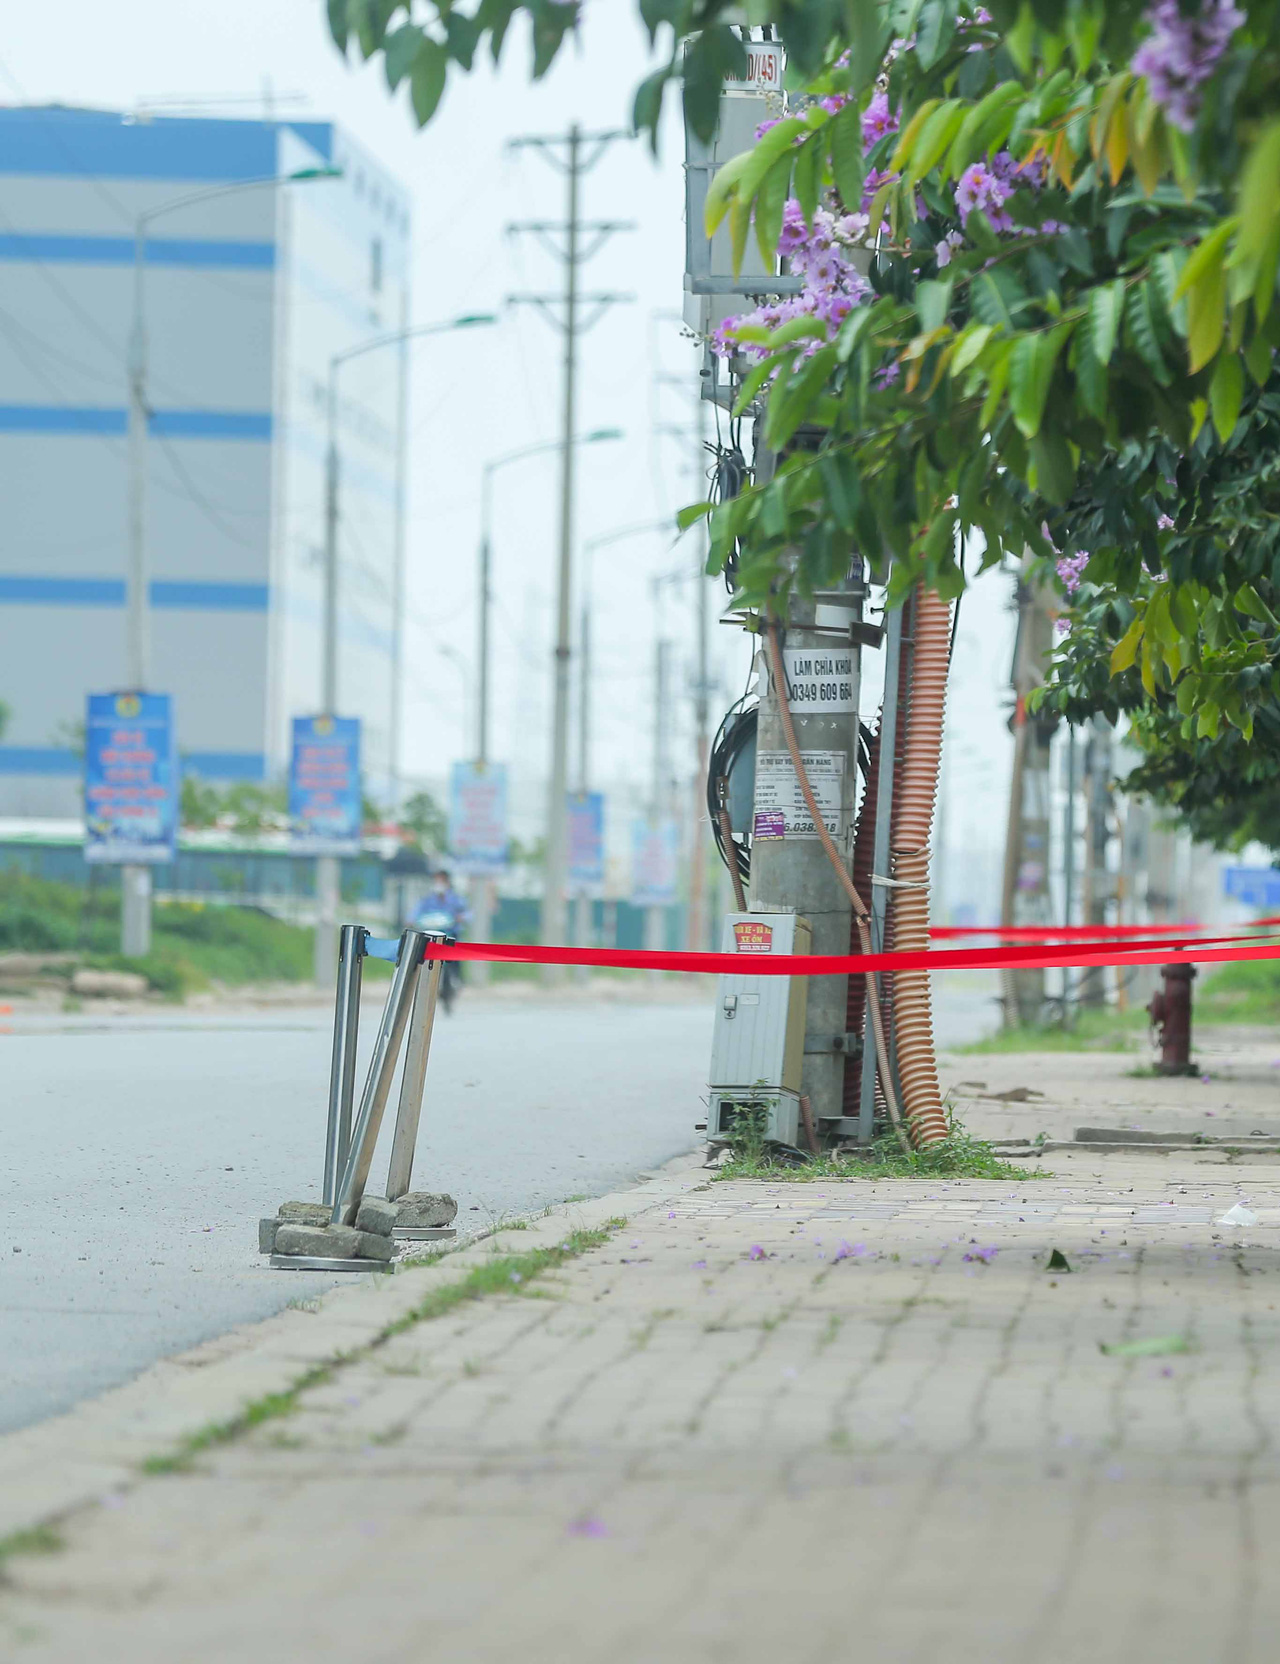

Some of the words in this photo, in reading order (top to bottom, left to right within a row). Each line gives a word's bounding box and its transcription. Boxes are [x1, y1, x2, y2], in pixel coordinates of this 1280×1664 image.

[794, 657, 812, 676] LÀM
[815, 657, 833, 675] CHÌA
[792, 683, 817, 701] 0349
[820, 683, 837, 701] 609
